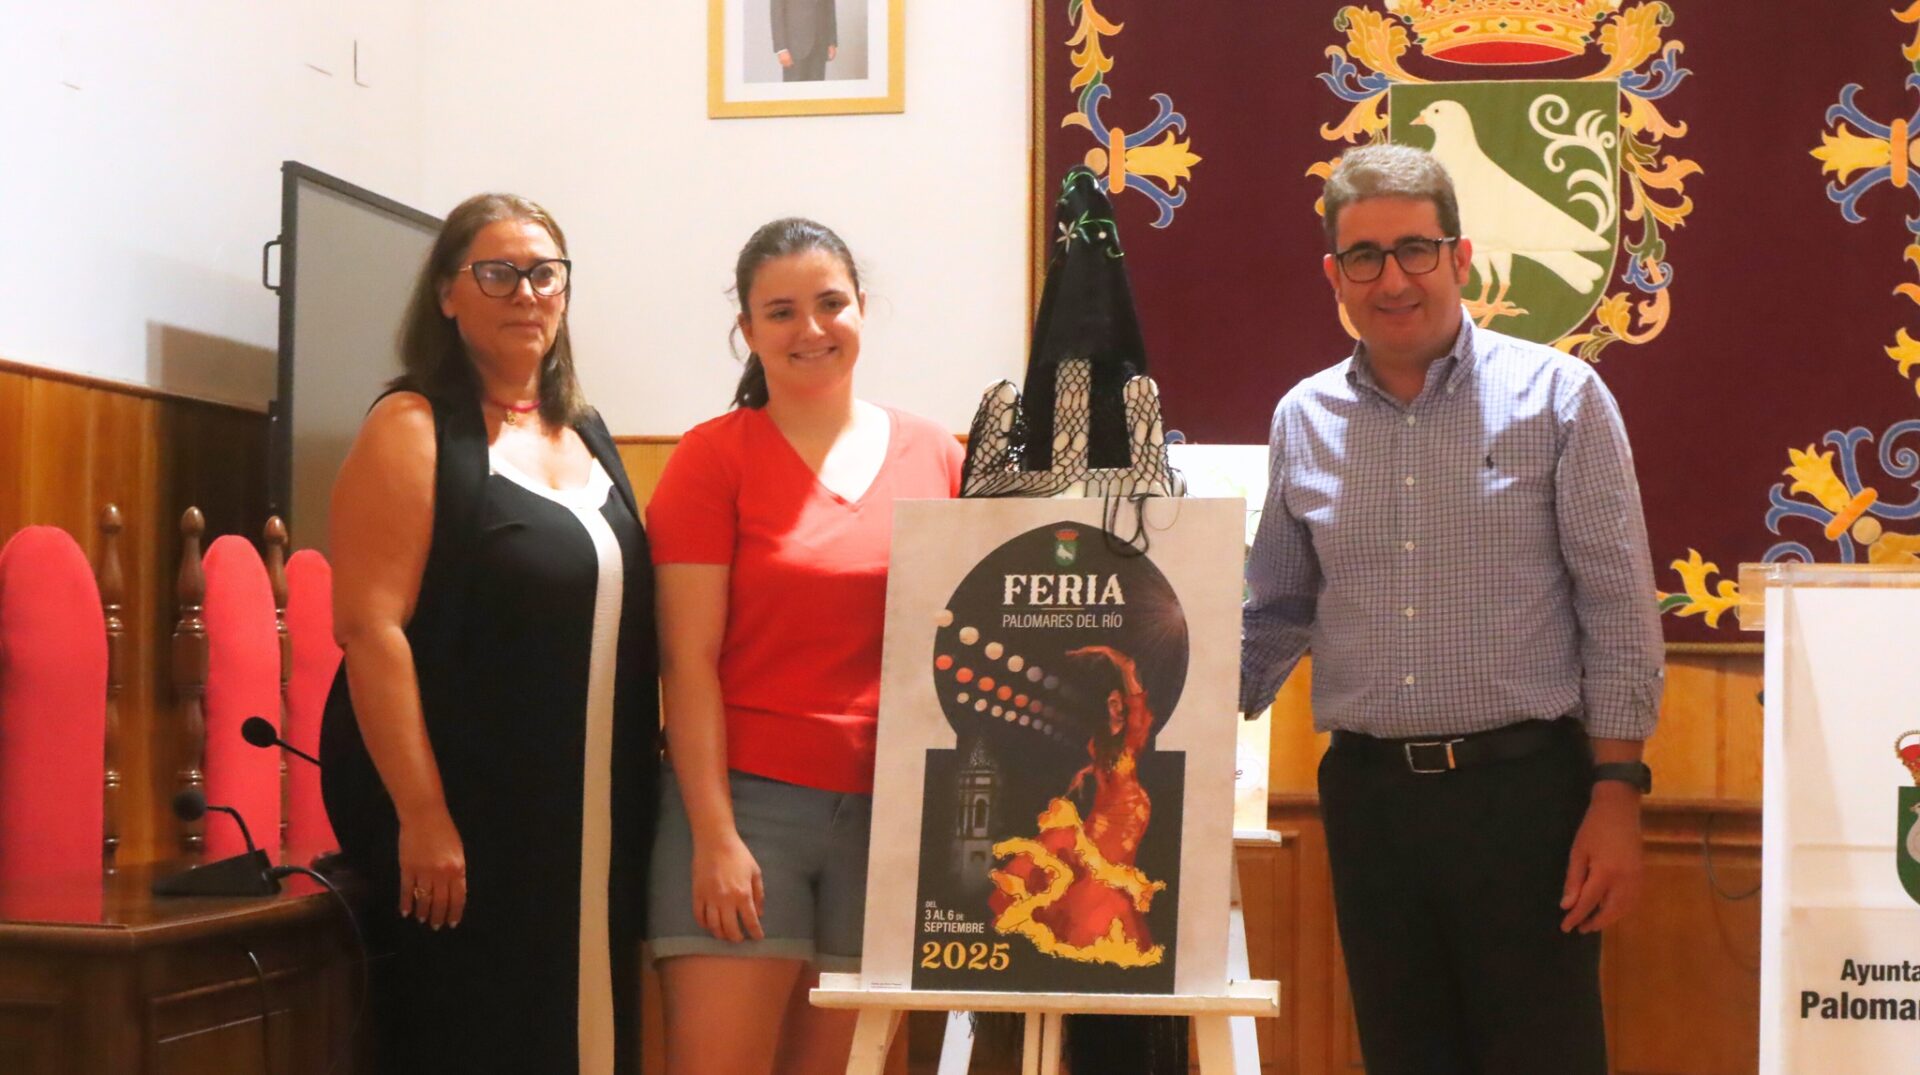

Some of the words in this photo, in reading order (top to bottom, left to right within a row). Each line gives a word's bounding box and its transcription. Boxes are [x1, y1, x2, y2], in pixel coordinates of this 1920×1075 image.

[1002, 573, 1126, 606] FERIA
[1002, 614, 1074, 629] PALOMARES
[1076, 614, 1099, 628] DEL
[1102, 611, 1123, 629] RÍO
[925, 900, 937, 908] DEL
[924, 909, 931, 921] 3
[933, 909, 945, 921] AL
[947, 909, 955, 921] 6
[956, 913, 965, 921] DE
[923, 921, 985, 934] SEPTIEMBRE
[920, 941, 1010, 971] 2025
[1800, 991, 1920, 1021] Paloma
